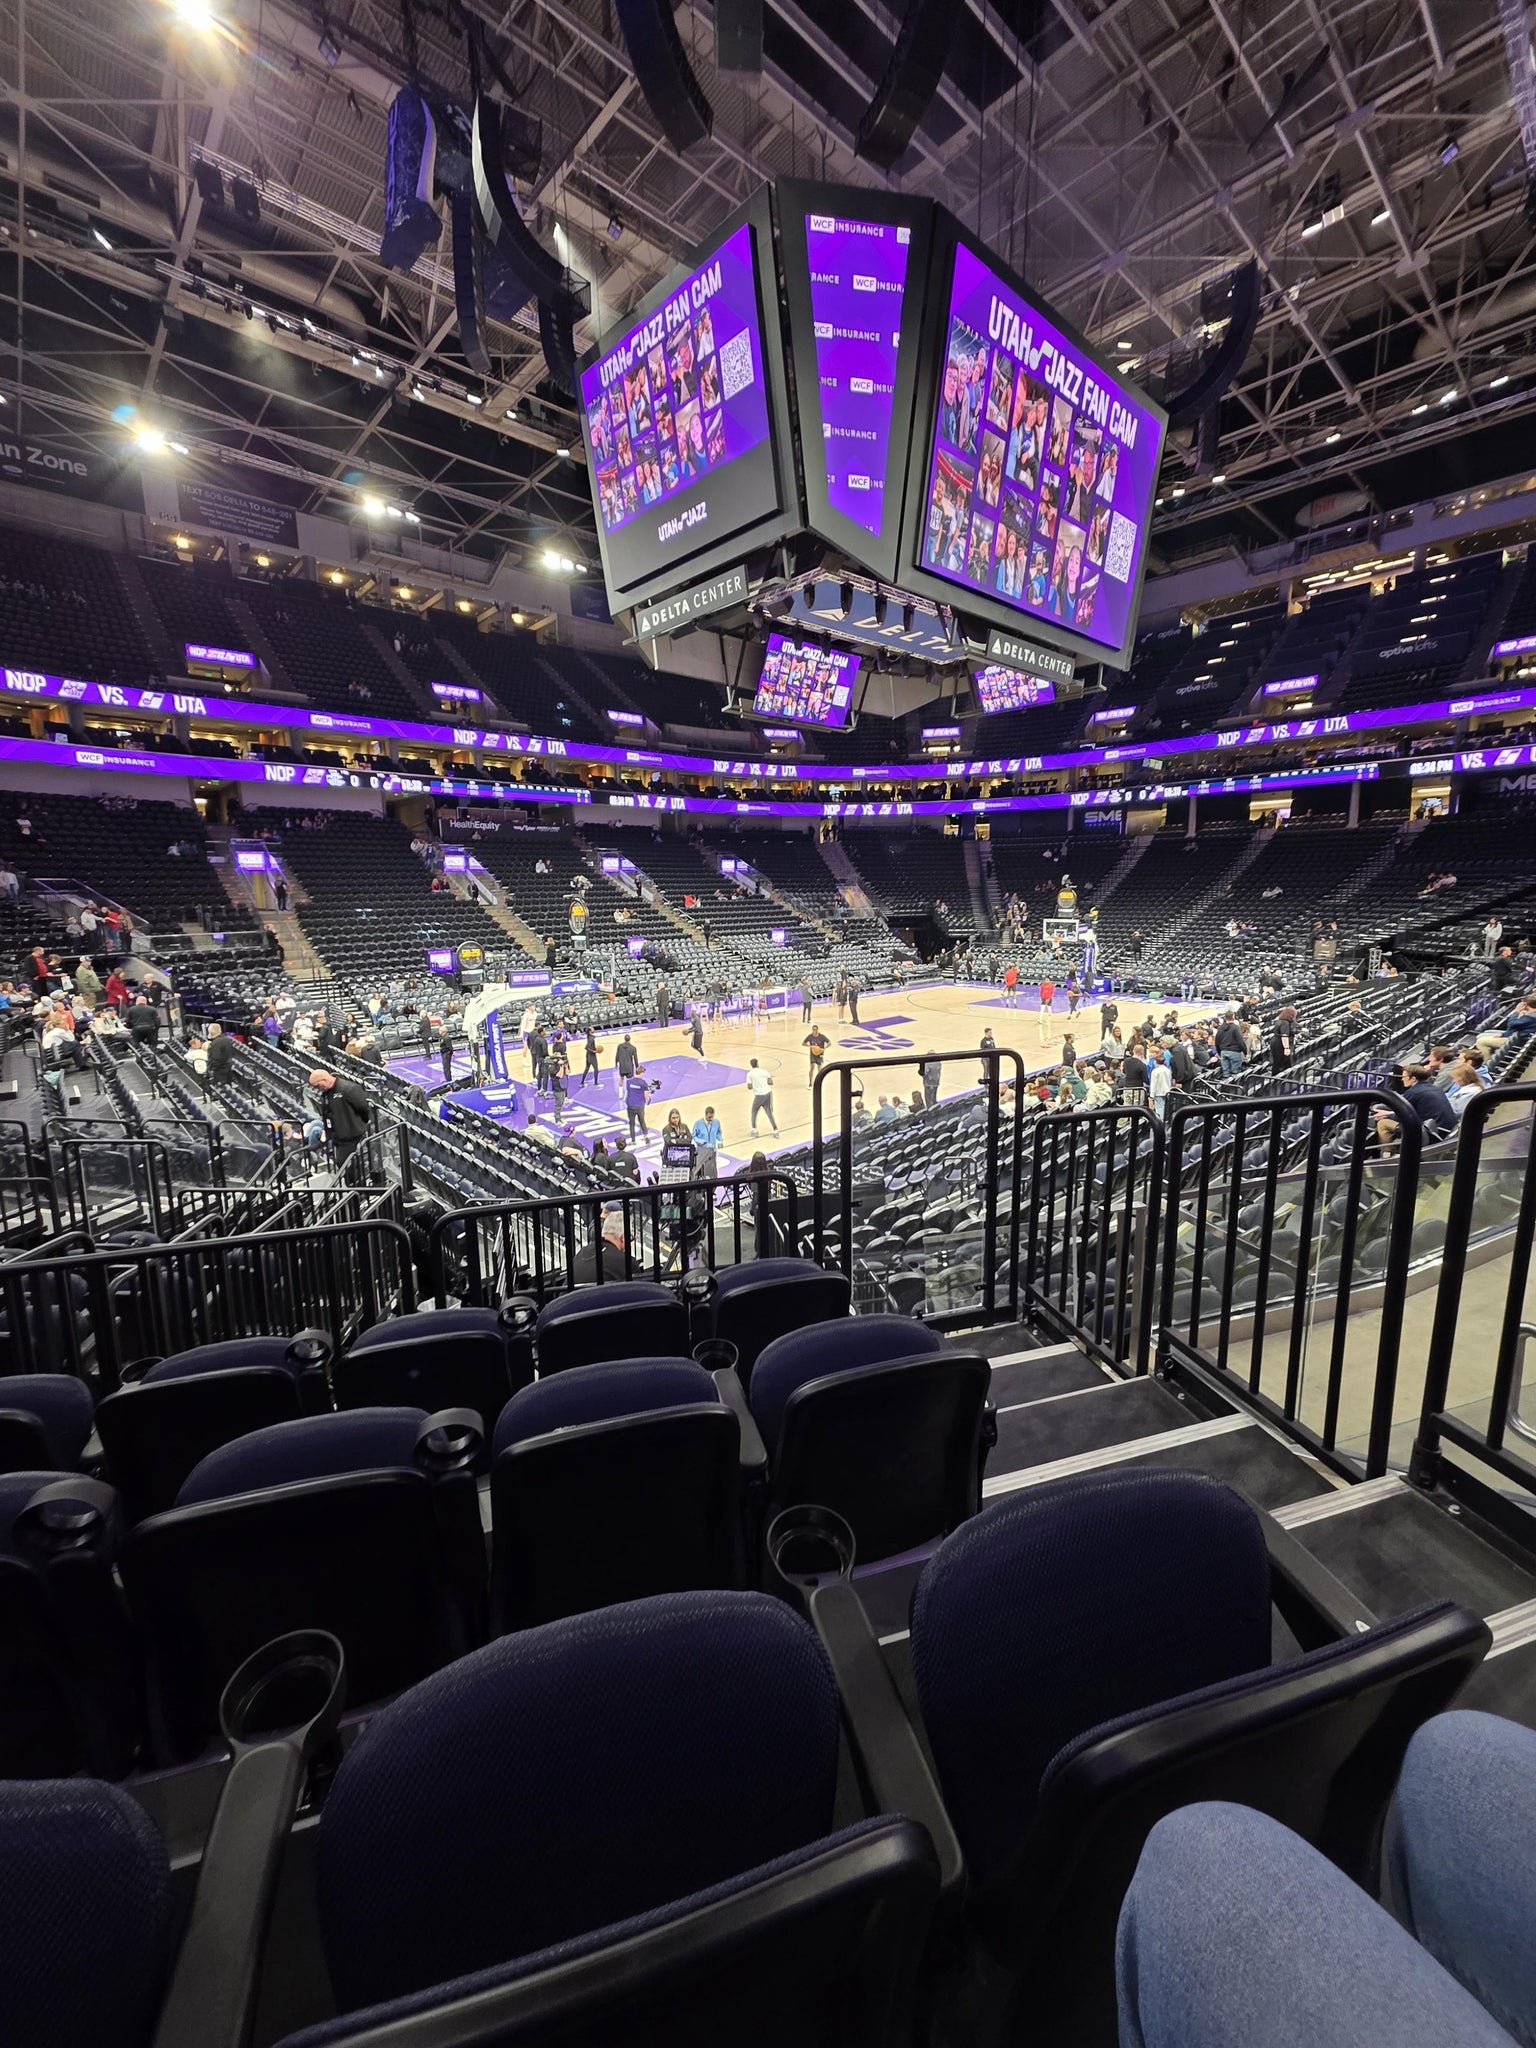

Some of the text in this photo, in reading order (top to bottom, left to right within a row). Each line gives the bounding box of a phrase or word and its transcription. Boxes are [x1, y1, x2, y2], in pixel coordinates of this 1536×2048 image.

[813, 219, 833, 229] WCF
[835, 223, 884, 238] INSURANCE
[855, 278, 904, 293] WCF INSUR
[600, 260, 723, 388] UTAH JAZZ FAN CAM
[833, 327, 881, 342] INSURANCE
[988, 294, 1139, 450] UTAH JAZZ FAN CAM
[819, 376, 894, 393] NCE WCF INSU
[831, 427, 877, 440] INSURANCE
[25, 446, 88, 477] Zone
[850, 477, 886, 489] WCF INS
[182, 484, 203, 497] TEXT
[223, 495, 248, 508] DELTA
[249, 502, 261, 511] TO
[657, 501, 708, 542] UTAH JAZZ
[651, 575, 742, 627] DELTA CENTER
[852, 616, 953, 653] DELTA
[1003, 641, 1072, 677] DELTA CENTER
[1379, 645, 1414, 660] aptive
[834, 654, 849, 669] CAM
[5, 669, 207, 715] NOP VS. UTA
[1176, 684, 1200, 696] aptive
[1454, 695, 1521, 712] WCF INSURANCE
[314, 716, 371, 729] WCF INSURANCE
[1217, 716, 1349, 746] NOP VS. UTA
[453, 729, 567, 756] NOP VS. UTA
[80, 753, 156, 767] WCF INSURANCE
[947, 757, 1042, 776] NOP VS. UTA
[1437, 759, 1454, 772] PM
[1461, 752, 1486, 769] VS.
[265, 764, 296, 782] NOP
[713, 760, 797, 777] NOP VS. UTA
[350, 775, 360, 787] 0
[370, 776, 380, 789] 0
[637, 794, 686, 810] VS. UTA
[1070, 792, 1089, 806] NOP
[1125, 790, 1132, 801] 0
[1139, 789, 1146, 800] 0
[823, 803, 913, 816] NOP VS. UTA
[449, 819, 501, 831] HealthEquity
